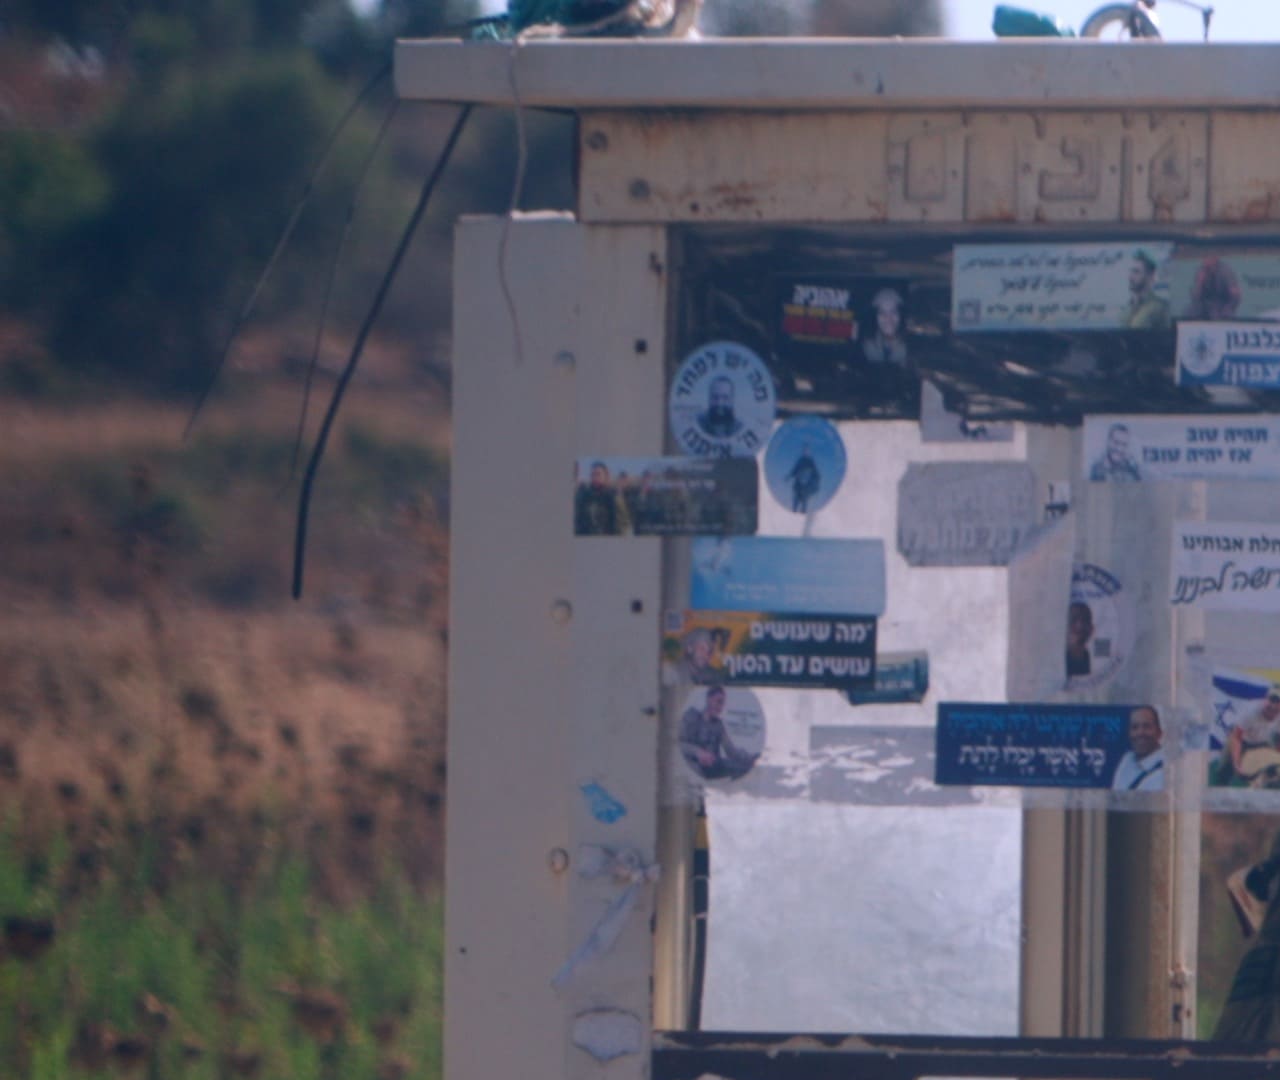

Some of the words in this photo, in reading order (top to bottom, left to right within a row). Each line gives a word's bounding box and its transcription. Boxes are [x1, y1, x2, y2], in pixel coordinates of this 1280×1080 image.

[725, 351, 750, 370] יש
[1185, 425, 1219, 443] טוב
[1223, 426, 1269, 444] תהיה
[1142, 446, 1181, 464] טוב!
[1185, 446, 1223, 464] יהיה
[1228, 446, 1256, 464] אז
[1181, 534, 1245, 551] אבותינו
[750, 621, 830, 642] שעושים
[776, 655, 804, 675] עד
[808, 656, 871, 677] עושים
